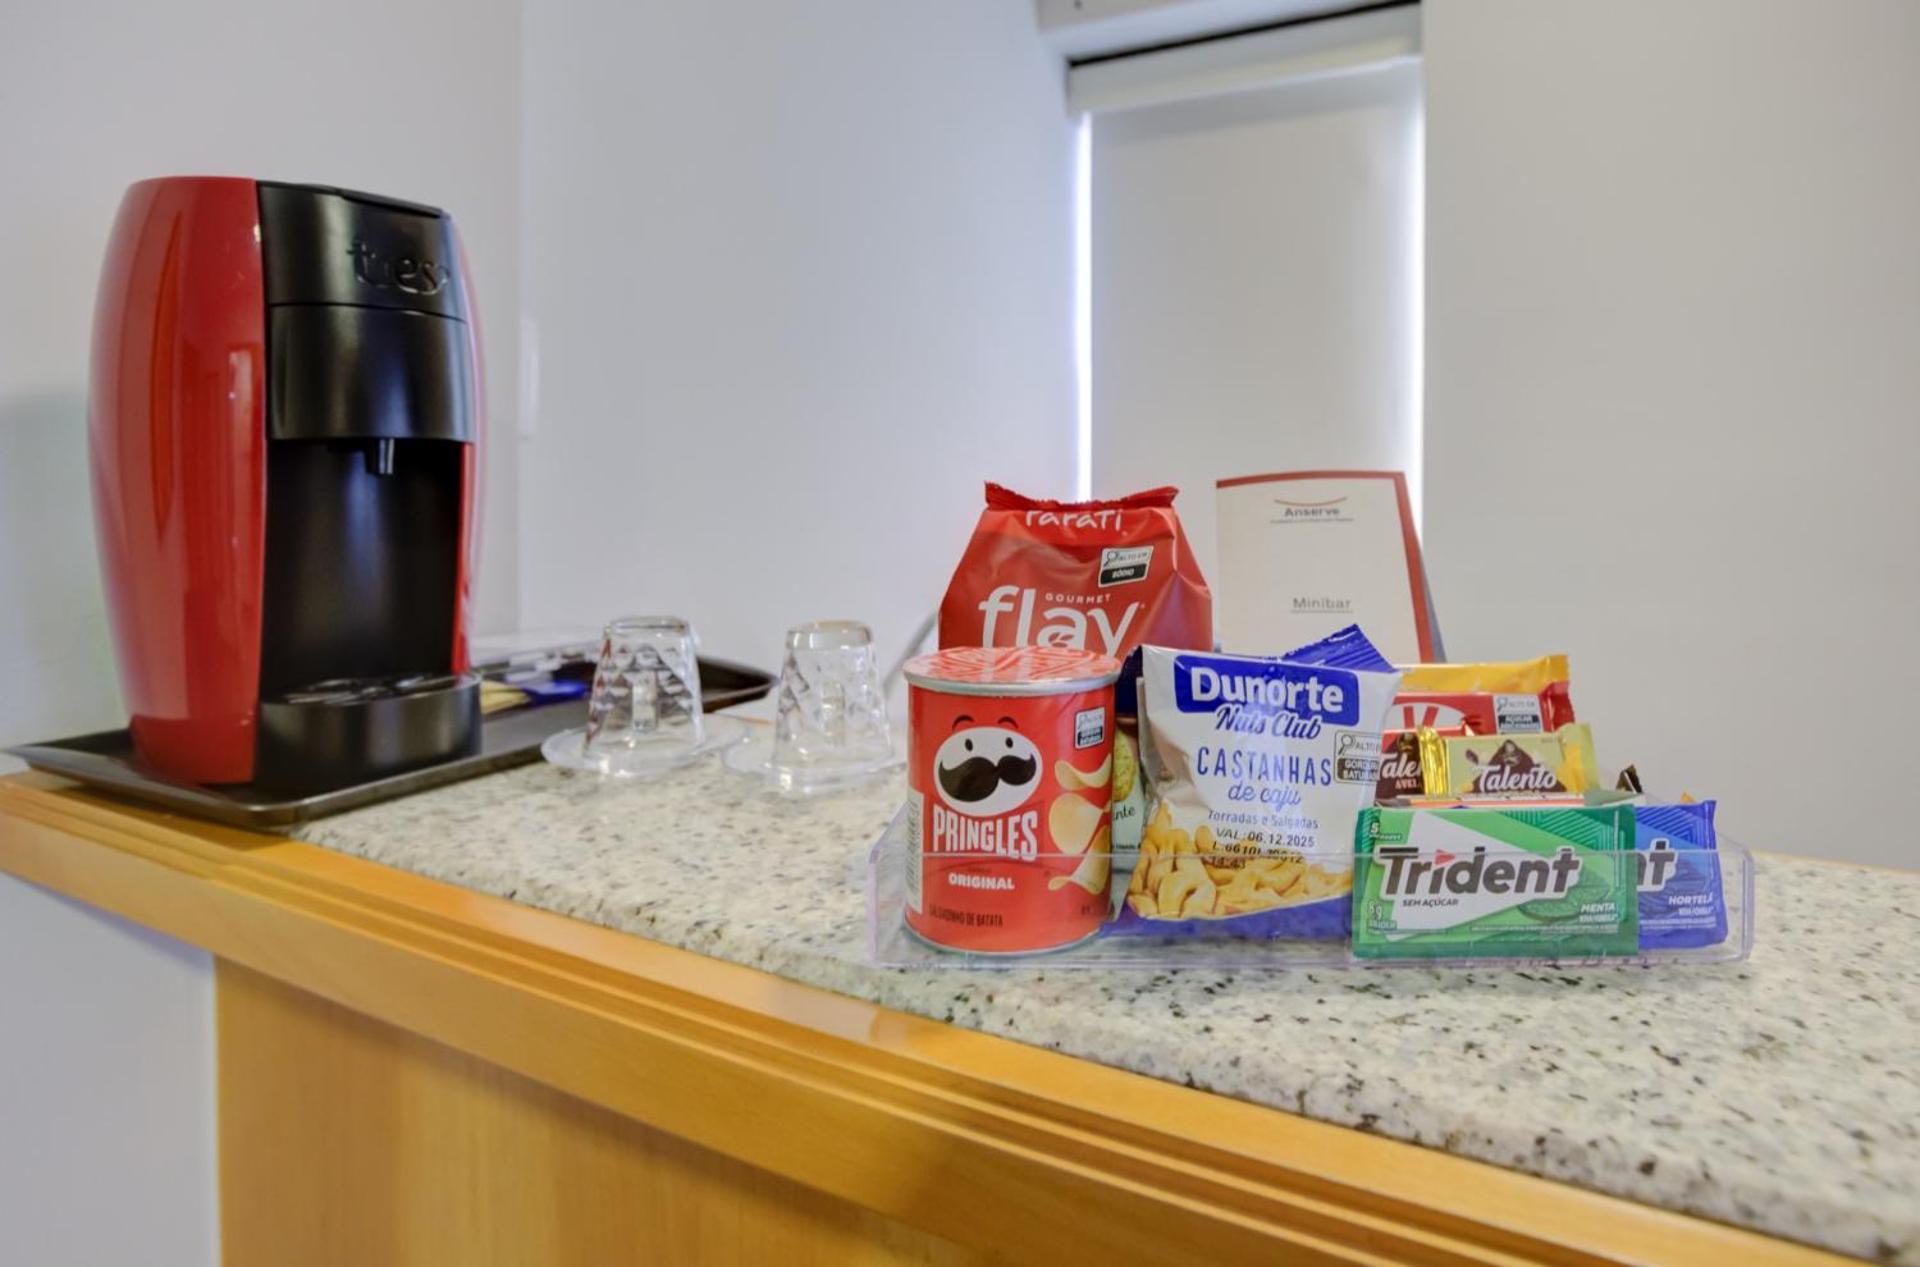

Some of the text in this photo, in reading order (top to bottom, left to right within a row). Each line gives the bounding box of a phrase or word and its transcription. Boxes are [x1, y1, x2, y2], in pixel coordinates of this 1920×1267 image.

[1045, 592, 1112, 604] GOURMET
[1292, 597, 1350, 610] Minibar
[1190, 667, 1344, 713] Dunorte
[1216, 703, 1322, 740] Nuts Club
[1197, 746, 1333, 786] CASTANHAS
[1479, 763, 1557, 794] Talento
[1228, 781, 1302, 813] de caju
[932, 803, 1038, 861] PRINGLES
[948, 872, 1015, 892] ORIGINAL
[1379, 846, 1580, 895] Trident
[1580, 902, 1616, 913] MENTA
